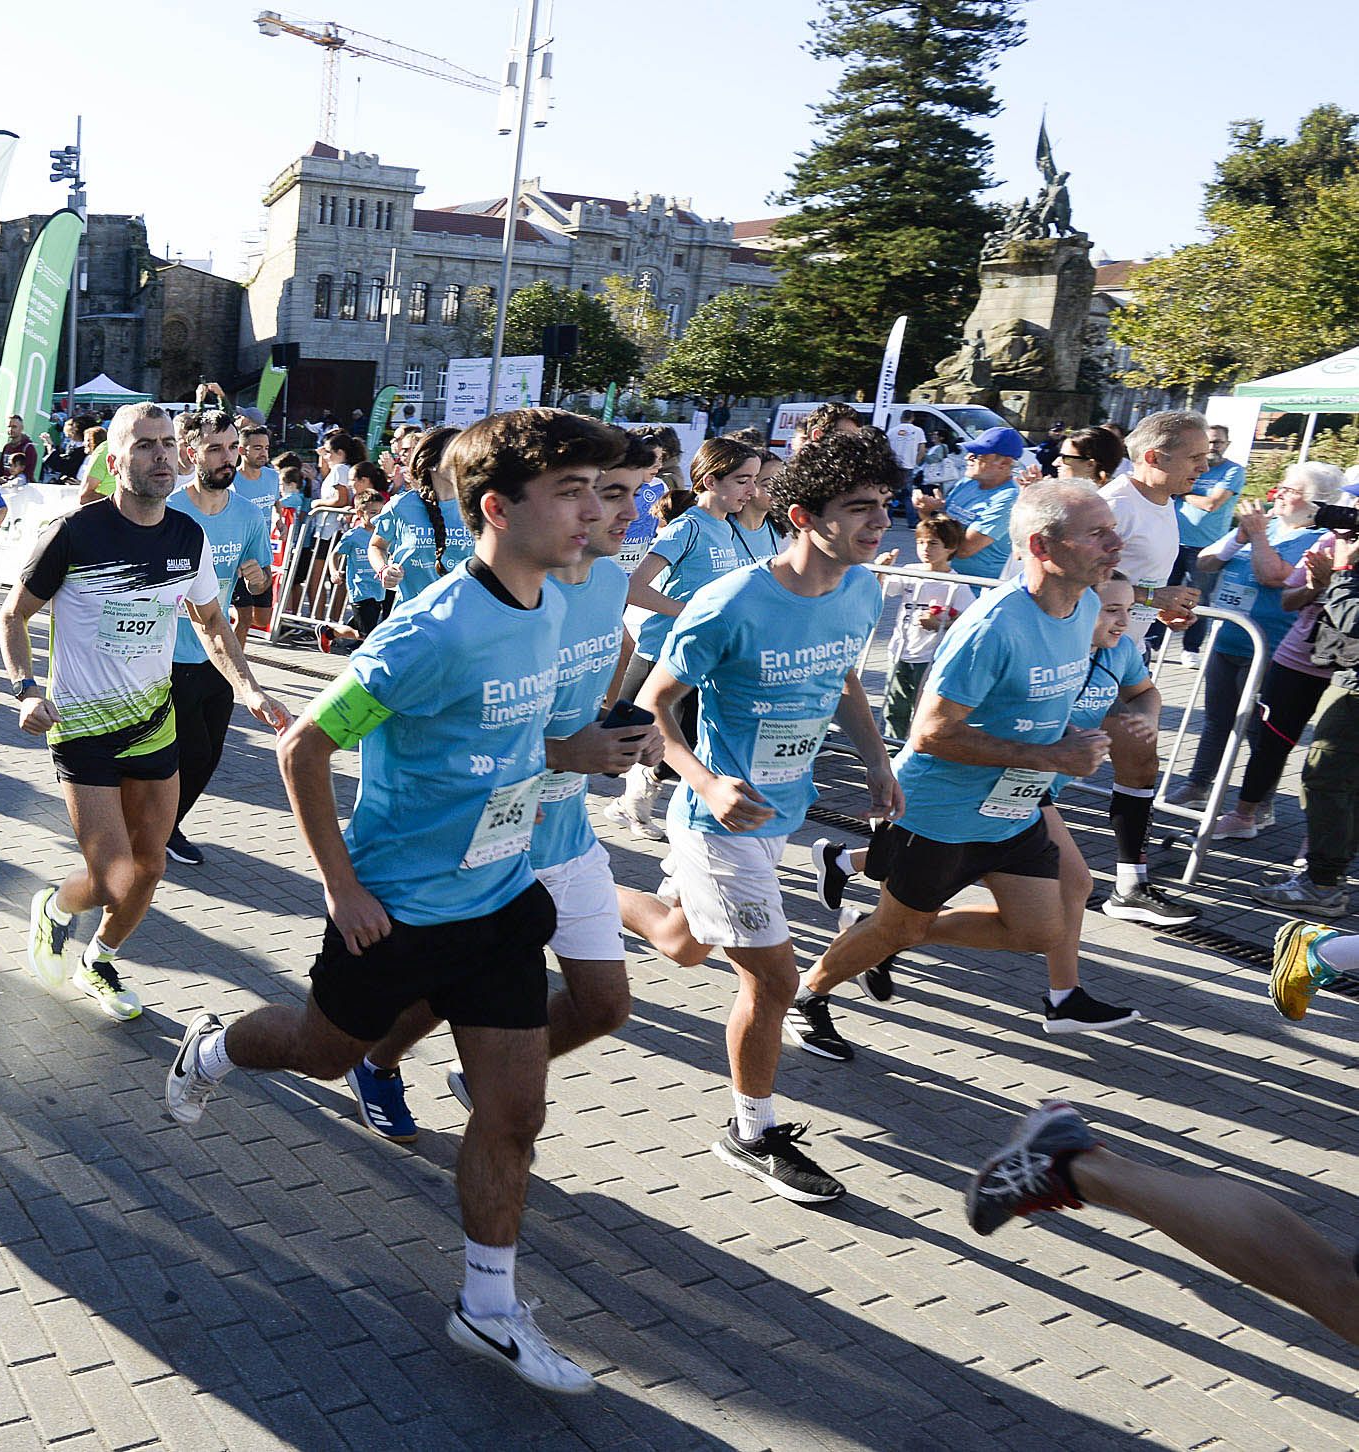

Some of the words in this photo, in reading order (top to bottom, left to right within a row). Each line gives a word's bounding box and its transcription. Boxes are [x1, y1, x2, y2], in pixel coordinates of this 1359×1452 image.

[408, 524, 426, 536] En
[211, 542, 242, 553] archa
[116, 620, 157, 635] 1297
[573, 626, 624, 659] march
[760, 649, 791, 669] En
[795, 634, 863, 665] marcha
[1029, 666, 1055, 685] En
[482, 679, 516, 705] En
[774, 736, 818, 757] 2186
